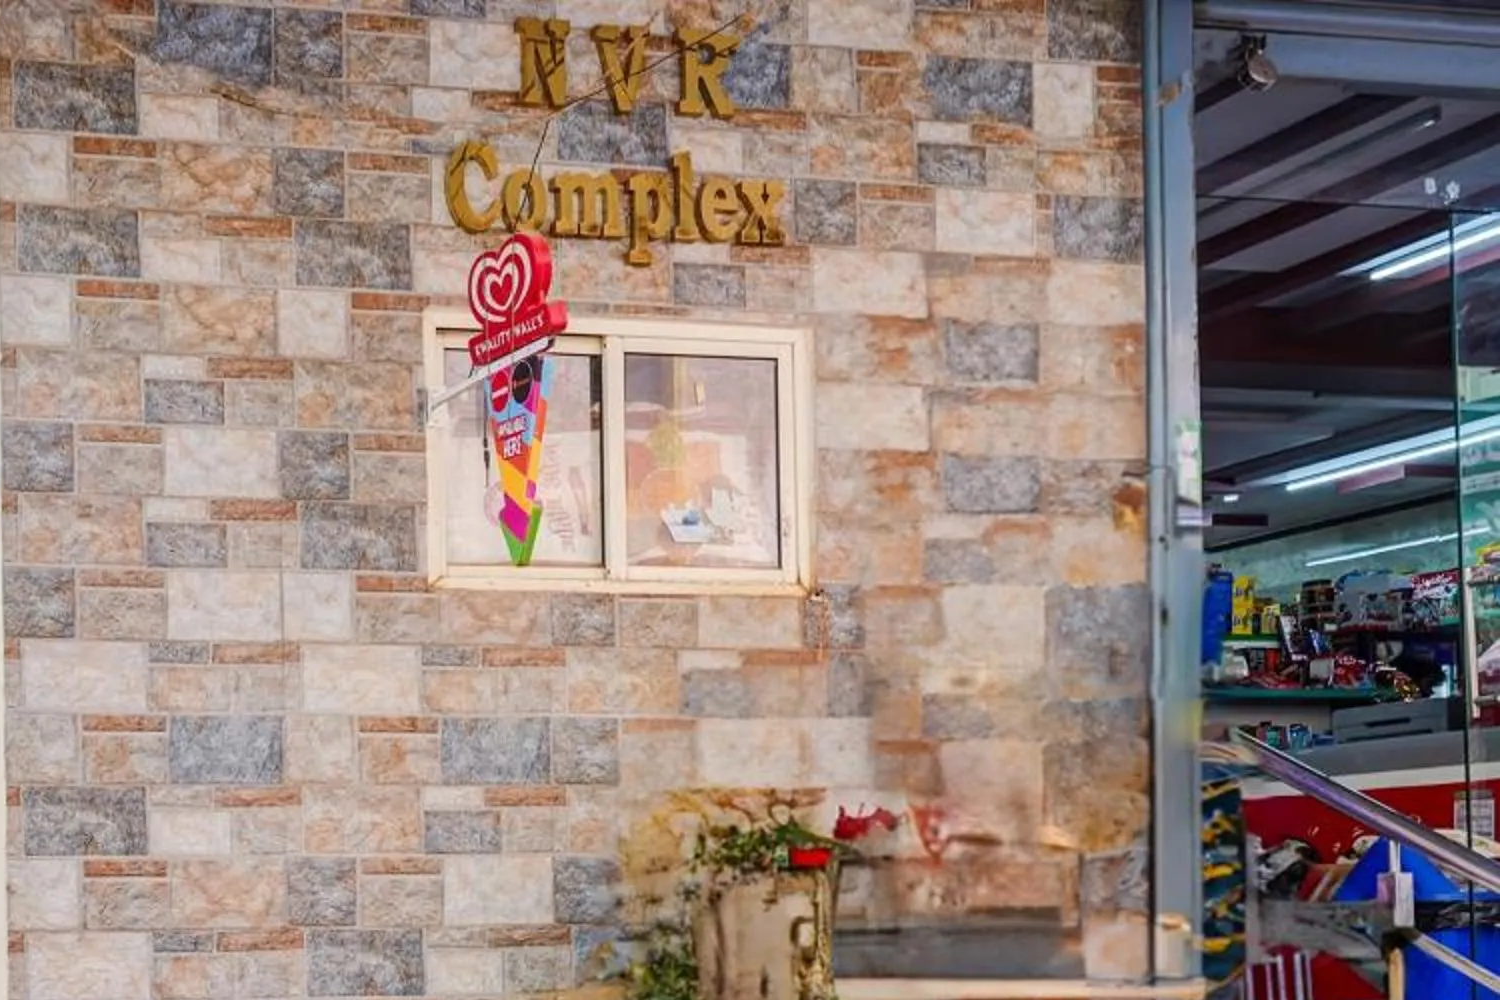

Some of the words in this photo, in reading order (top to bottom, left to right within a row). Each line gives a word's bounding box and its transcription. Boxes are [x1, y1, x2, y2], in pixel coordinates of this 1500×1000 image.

[514, 16, 743, 119] NVR
[445, 140, 788, 267] Complex
[474, 327, 514, 358] KWALITY
